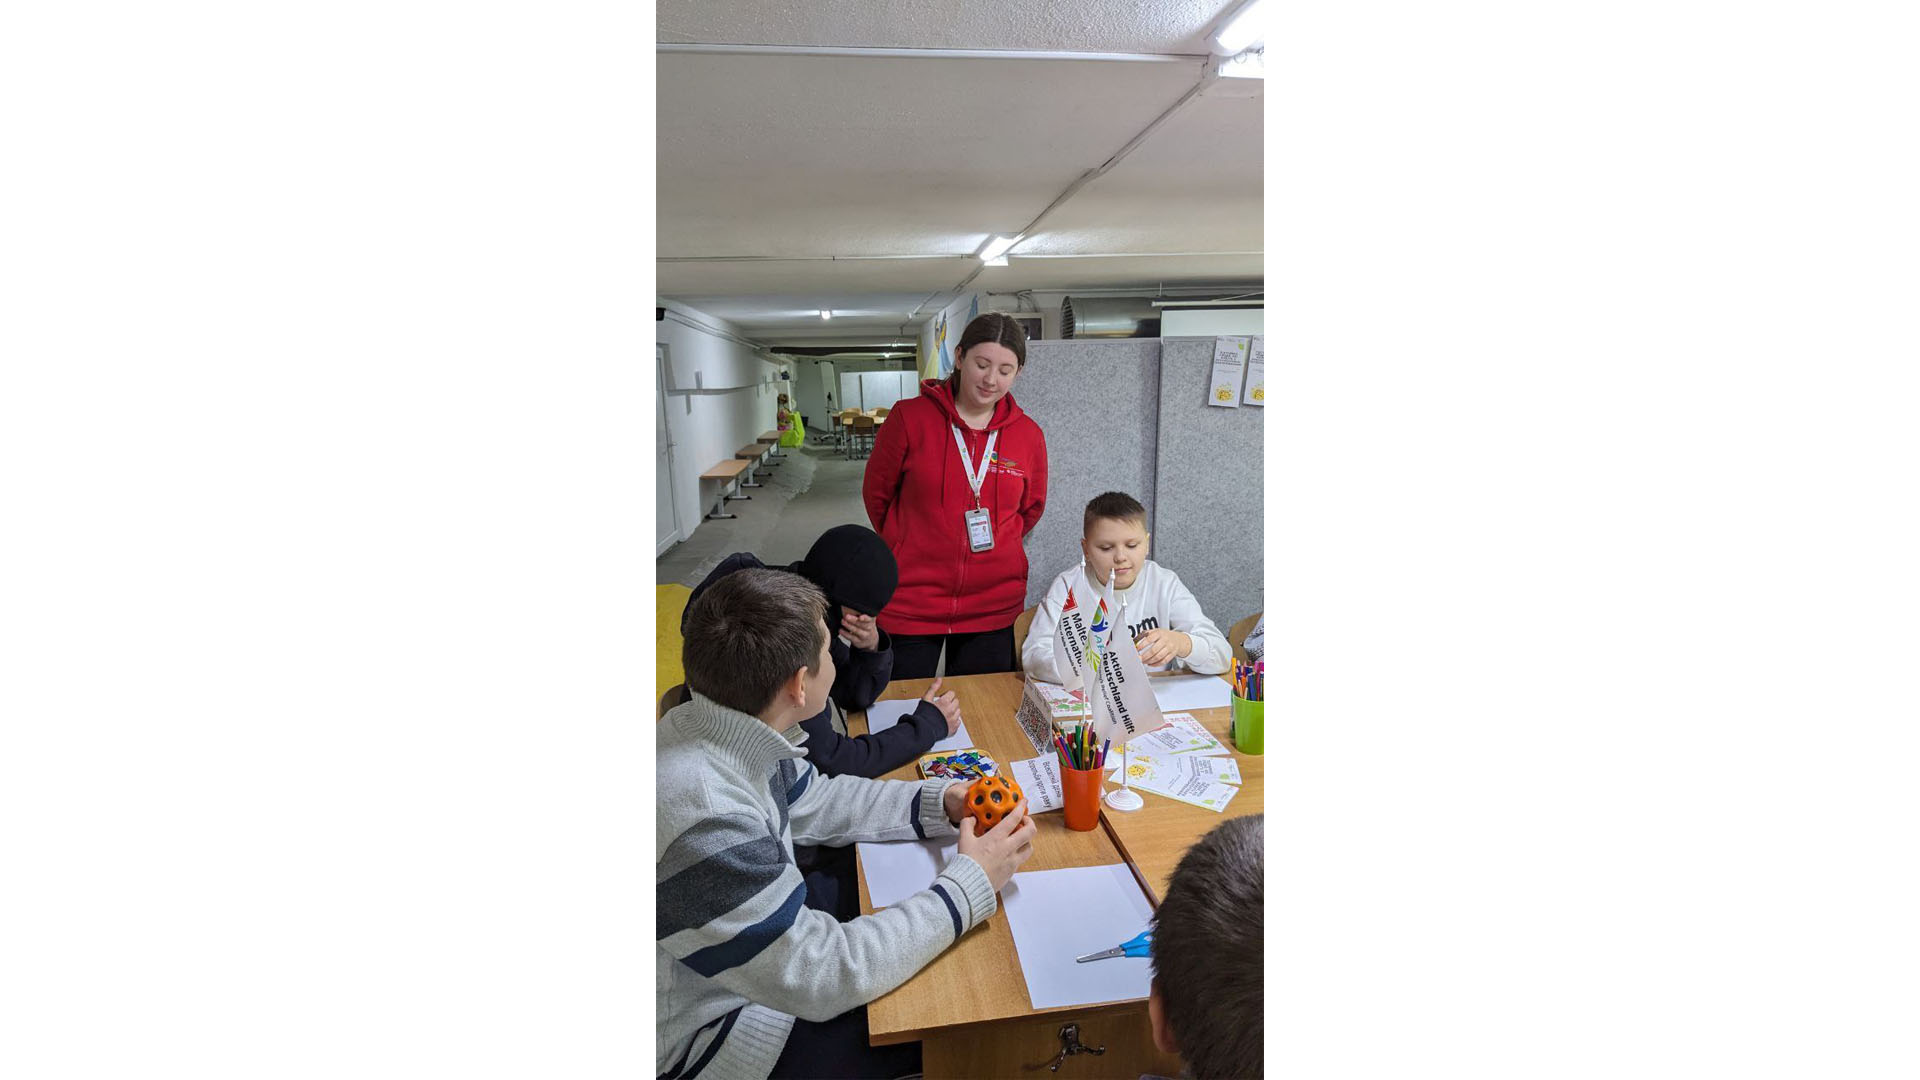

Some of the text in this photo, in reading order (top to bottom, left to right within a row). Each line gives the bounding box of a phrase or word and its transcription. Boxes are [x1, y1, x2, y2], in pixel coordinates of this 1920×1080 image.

[1062, 616, 1083, 667] Internatio
[1072, 612, 1088, 646] Malte
[1128, 616, 1159, 639] orm
[1108, 651, 1125, 684] Aktion
[1103, 653, 1136, 735] Deutschland Hilft
